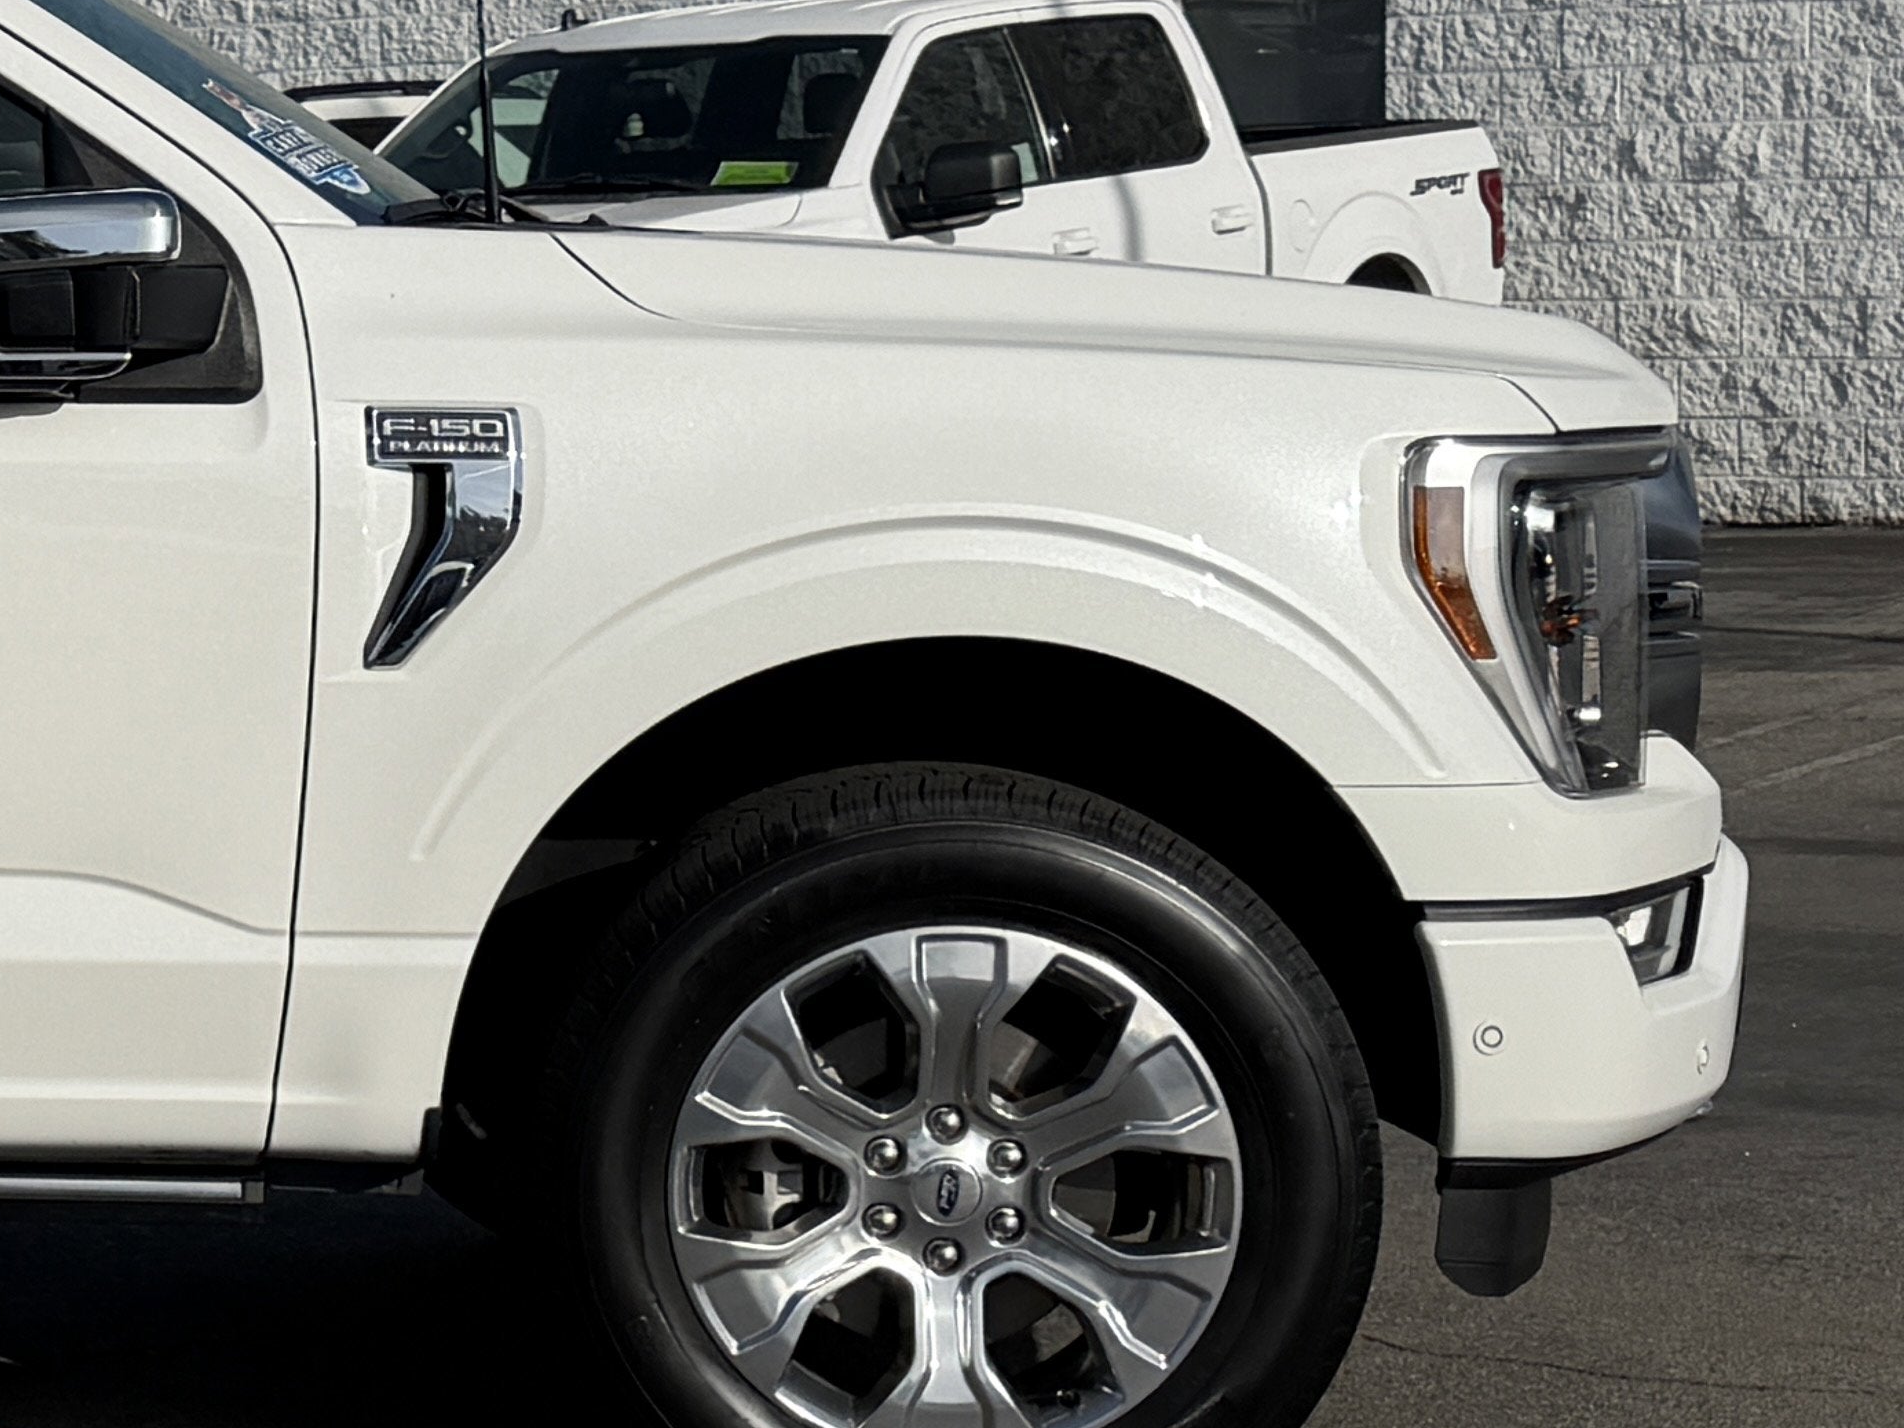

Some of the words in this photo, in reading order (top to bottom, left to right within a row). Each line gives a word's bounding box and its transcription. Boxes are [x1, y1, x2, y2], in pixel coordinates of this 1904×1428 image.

[1409, 172, 1471, 196] SPORT
[382, 417, 505, 437] F-150
[388, 440, 503, 454] PLATINUM
